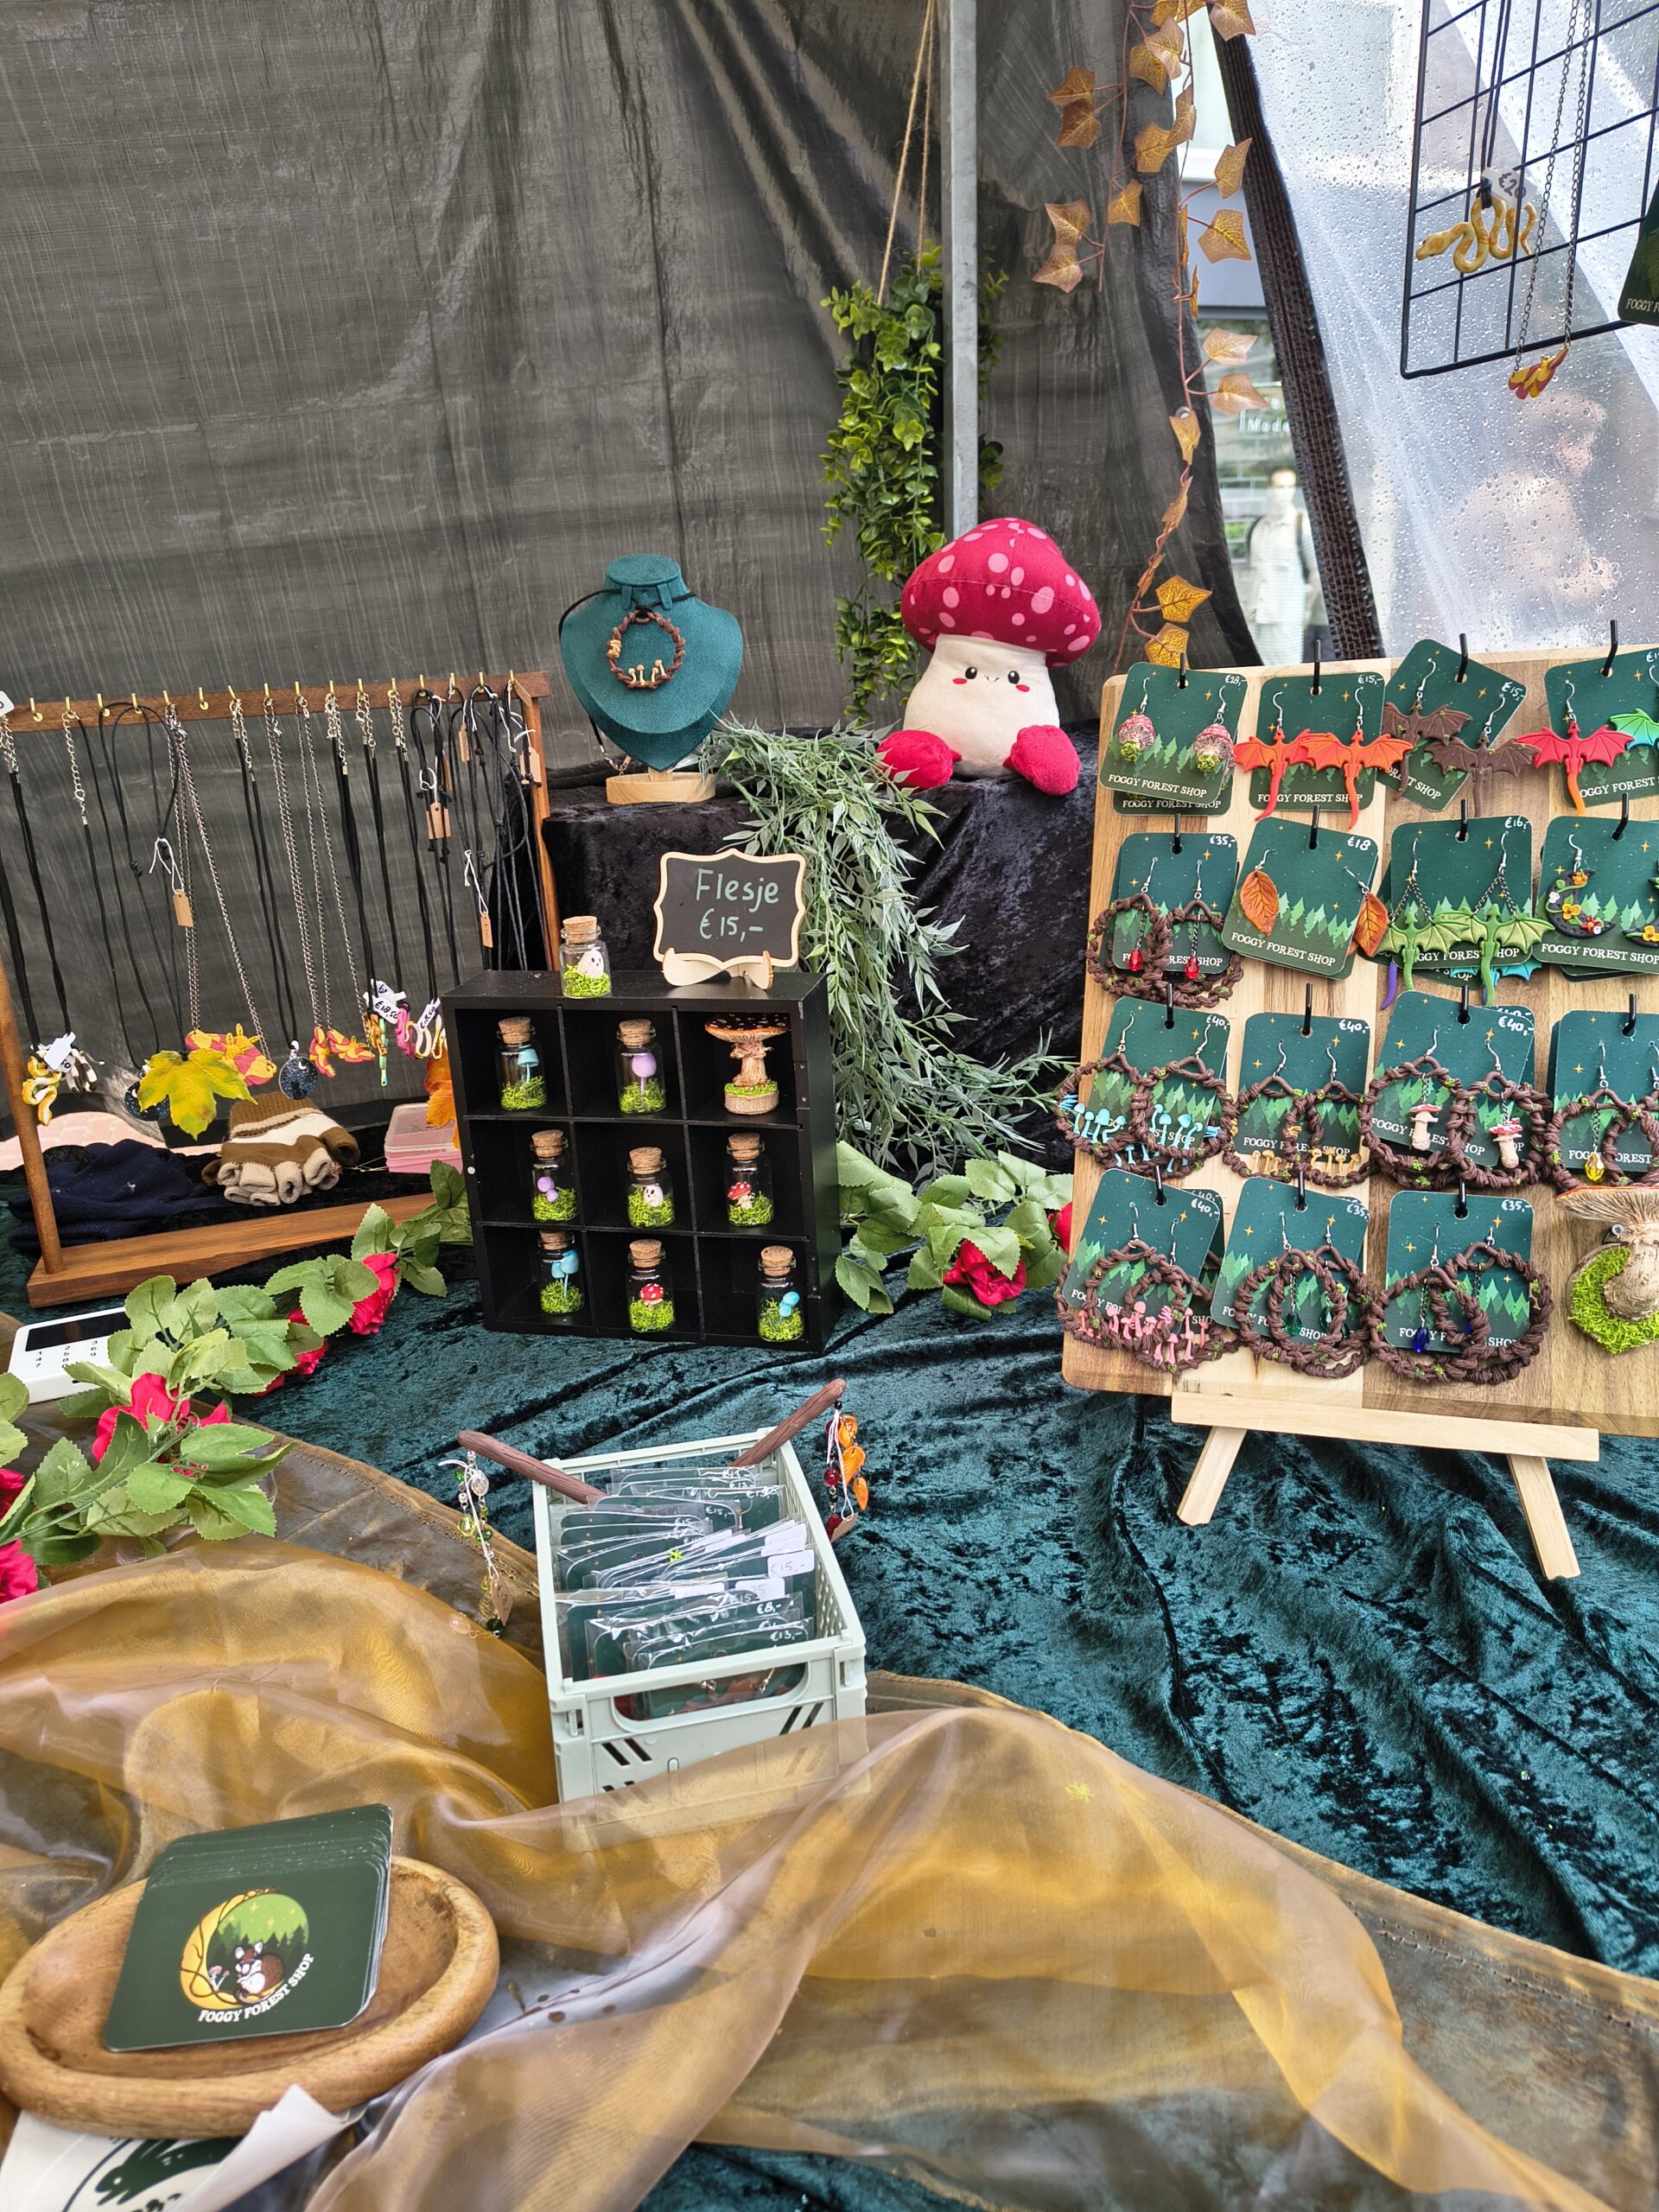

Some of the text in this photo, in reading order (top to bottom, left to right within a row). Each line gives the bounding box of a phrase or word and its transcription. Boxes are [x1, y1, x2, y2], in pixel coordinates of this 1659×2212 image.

[1625, 298, 1654, 313] FOGGY
[1646, 652, 1659, 662] €1
[1357, 675, 1383, 686] €15,-
[1109, 773, 1207, 798] FOGGY FOREST SHOP
[1414, 781, 1441, 799] SHOP
[1580, 784, 1611, 798] OGGY
[1612, 777, 1656, 792] FOREST
[1122, 799, 1154, 809] FOGGY
[1155, 799, 1193, 809] FOREST
[1257, 793, 1363, 804] FOGY FOREST SHP
[1210, 835, 1236, 848] €35,-
[1347, 836, 1371, 851] €18
[696, 868, 779, 913] Flesje
[1231, 931, 1336, 967] FOGGY FOREST SHOP
[1417, 948, 1520, 962] GGY FORES HOP
[1541, 943, 1659, 964] FOGGY FOREST SHOP
[1197, 956, 1223, 967] SHOP
[1338, 1019, 1370, 1033] €40,-
[1498, 1015, 1535, 1036] €40,-
[1243, 1136, 1278, 1149] FOGGY
[1464, 1141, 1485, 1156] HOP
[1615, 1152, 1652, 1164] OREST
[1071, 1288, 1105, 1307] FOY
[1192, 1315, 1213, 1325] SHO
[1400, 1327, 1437, 1340] FOY
[1488, 1337, 1516, 1348] SHO
[198, 1953, 314, 2023] FOGGY FOREST SHOP
